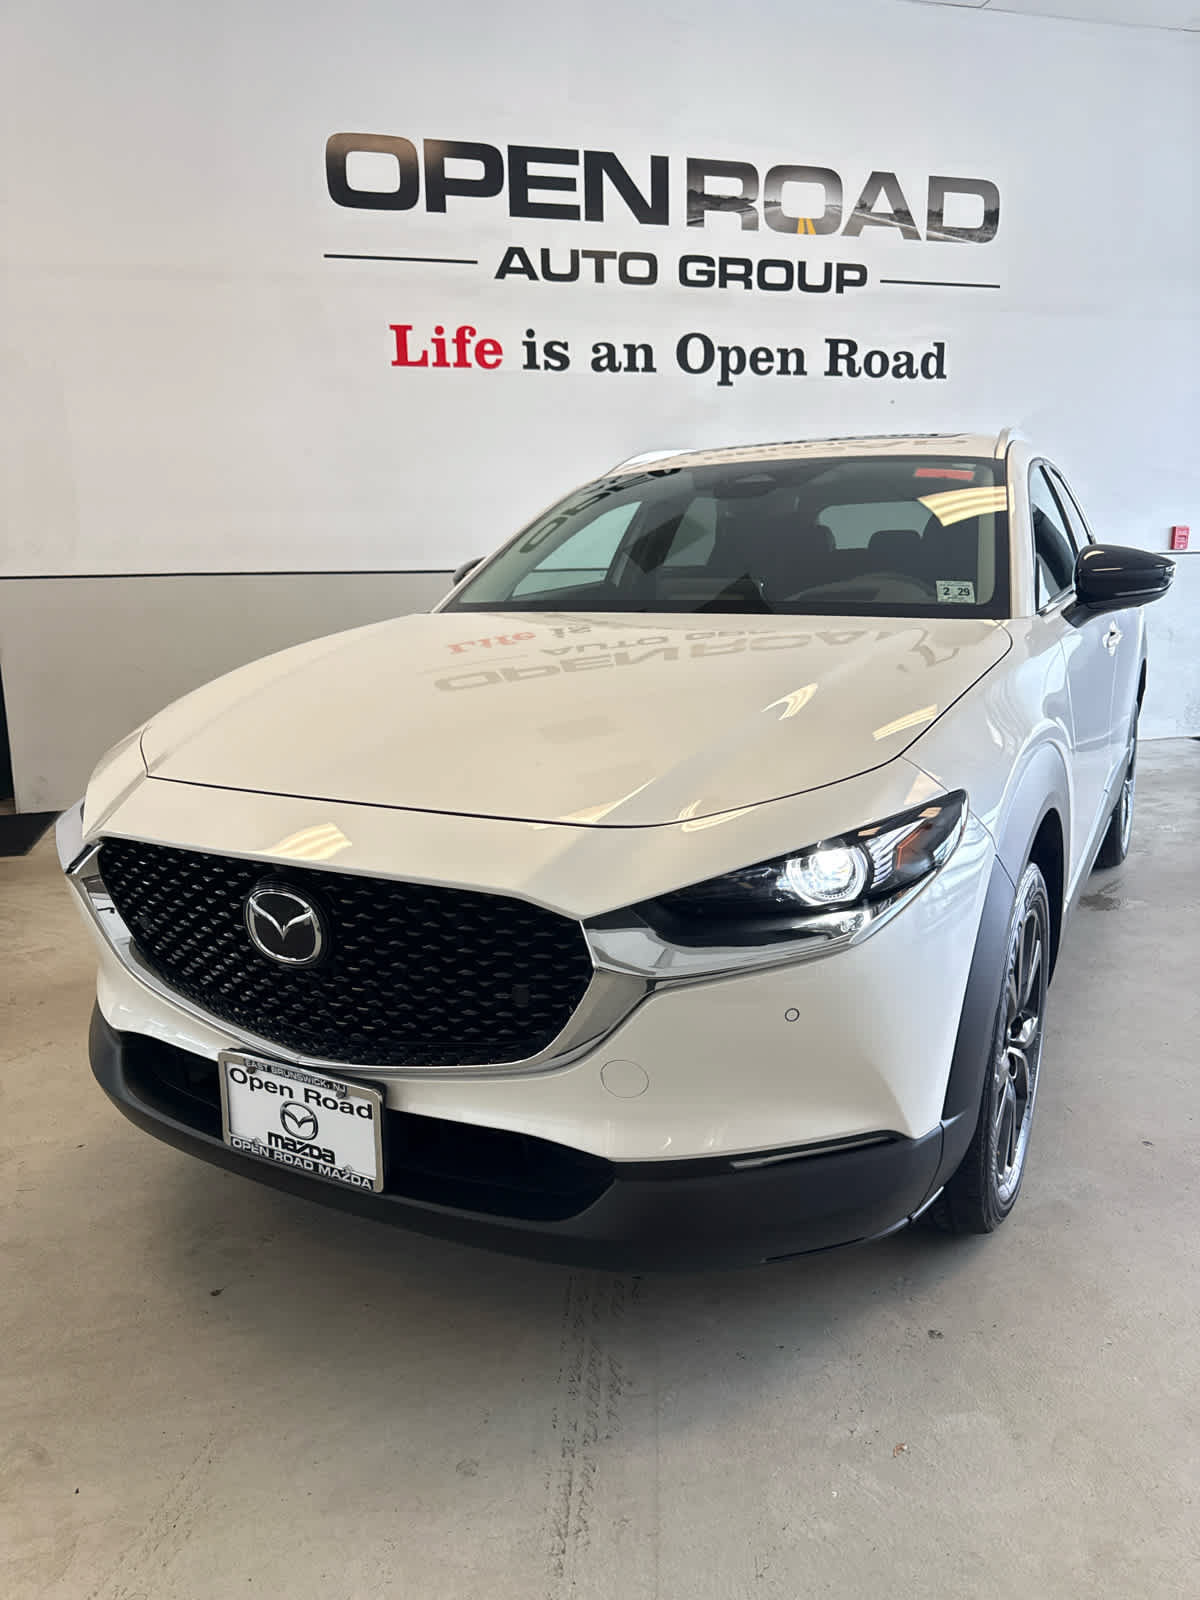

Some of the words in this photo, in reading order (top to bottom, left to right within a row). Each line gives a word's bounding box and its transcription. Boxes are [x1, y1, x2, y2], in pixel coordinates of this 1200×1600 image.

[324, 132, 670, 227] OPEN
[686, 157, 1001, 244] ROAD
[494, 246, 659, 286] AUTO
[678, 254, 868, 295] GROUP
[389, 324, 503, 369] Life
[521, 328, 571, 373] is
[590, 341, 657, 375] an
[675, 332, 809, 387] Open
[823, 337, 947, 380] Road
[958, 588, 970, 597] 29
[229, 1067, 294, 1099] Open
[303, 1087, 373, 1120] Road
[332, 1083, 346, 1092] NJ
[231, 1137, 270, 1158] OPEN
[273, 1151, 314, 1171] ROAD
[318, 1164, 373, 1191] MAZDA
